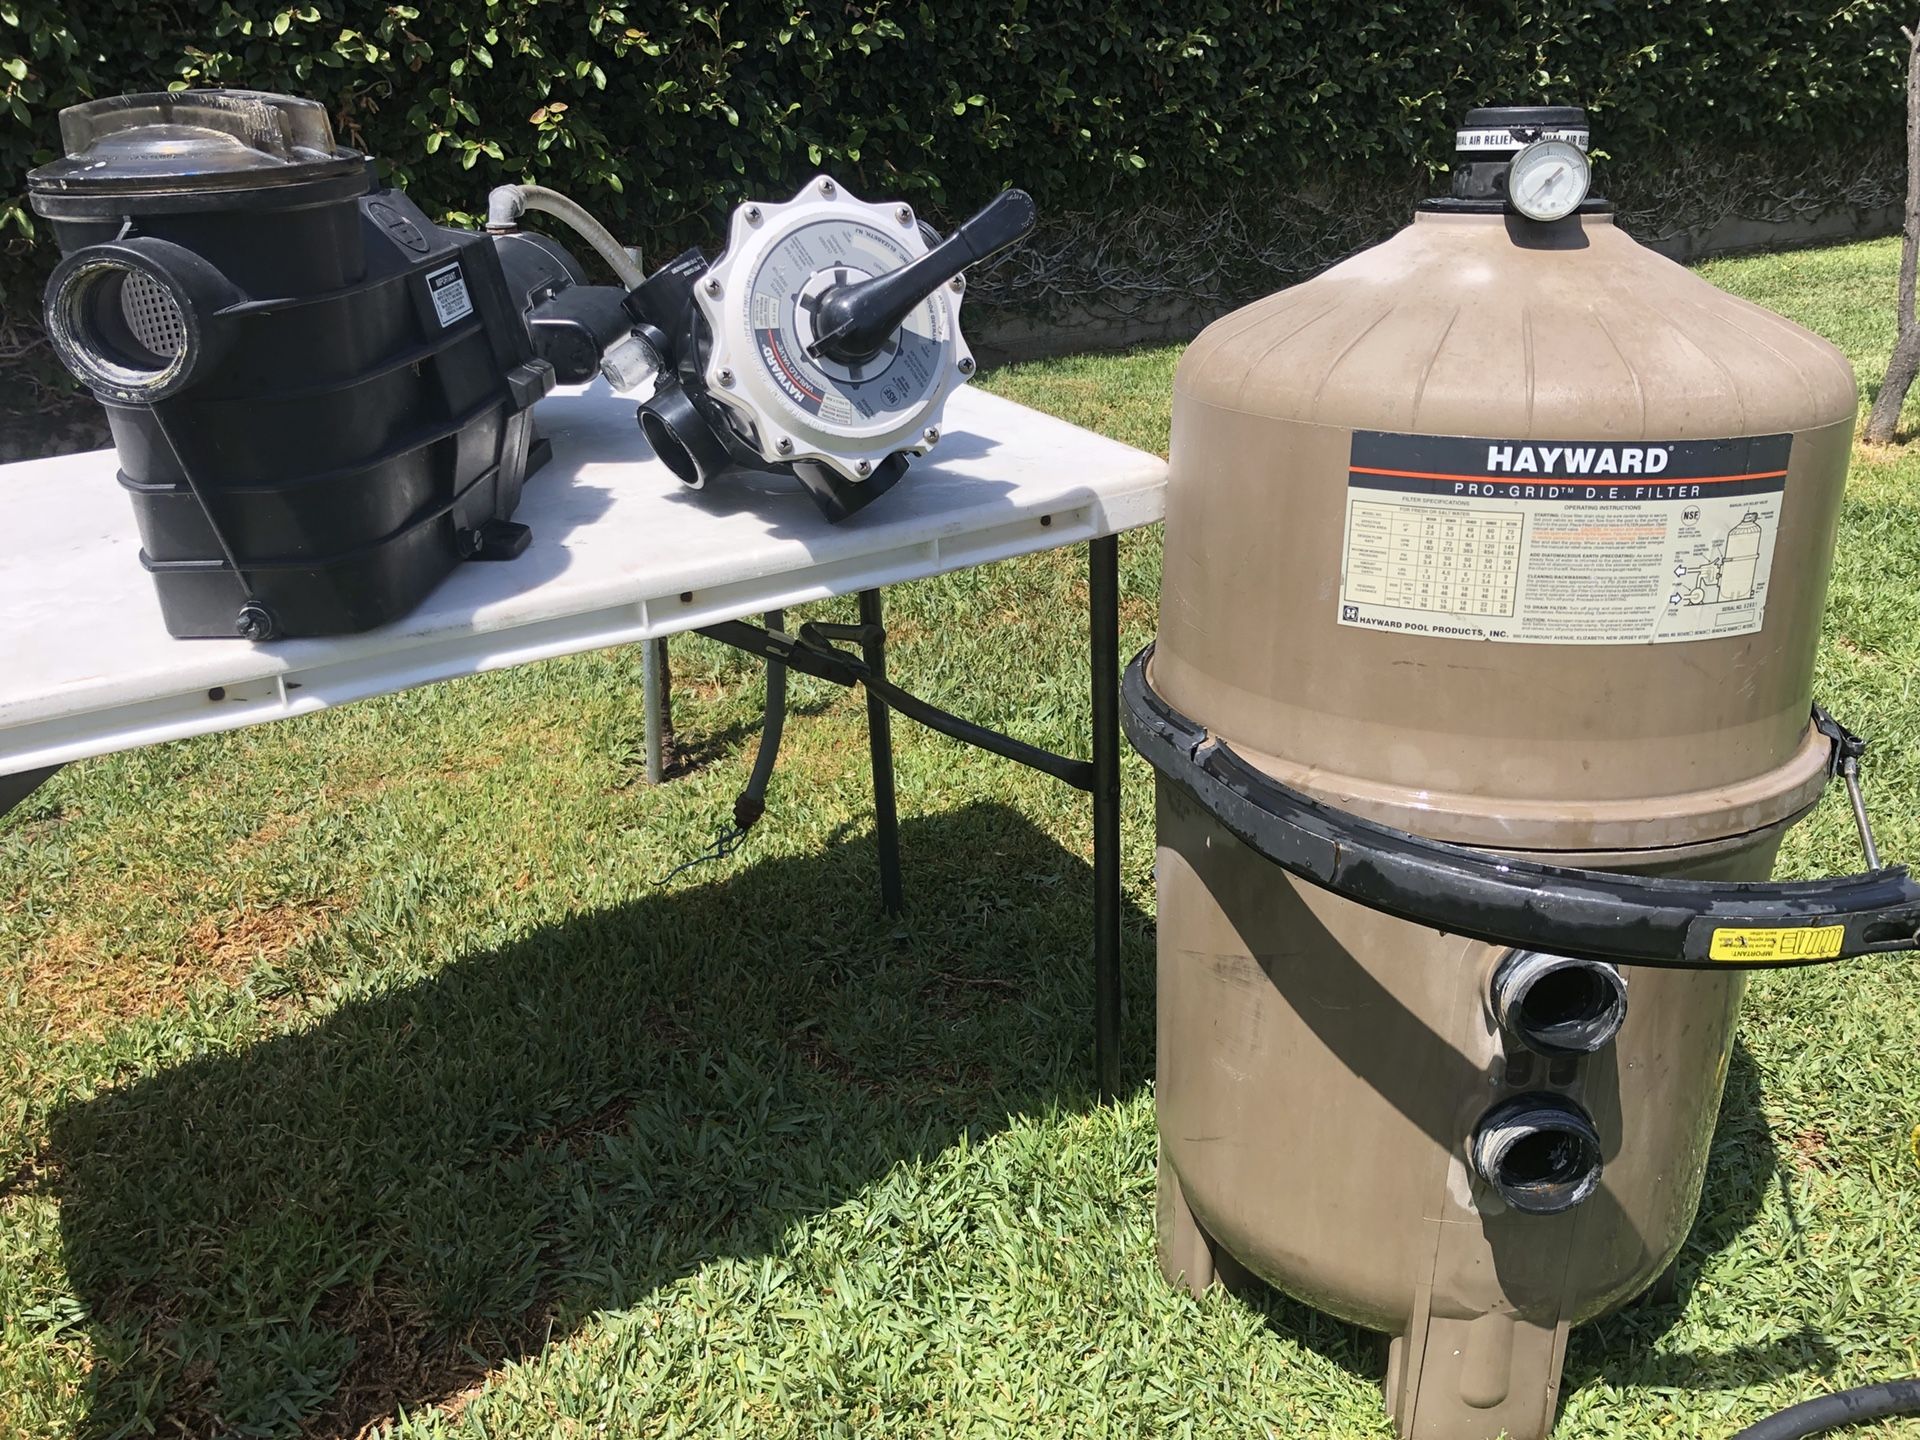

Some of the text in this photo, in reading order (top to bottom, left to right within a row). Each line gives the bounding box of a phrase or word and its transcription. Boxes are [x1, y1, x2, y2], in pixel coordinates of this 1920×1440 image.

[1469, 136, 1480, 145] AIR
[1484, 134, 1513, 145] RELIEF
[1566, 134, 1578, 145] AIR
[884, 388, 898, 404] NSF
[1636, 486, 1700, 498] FILTER
[1422, 498, 1470, 506] SPECIFICATIONS
[1684, 511, 1699, 520] NSF
[1360, 617, 1509, 638] HAYWARD POOL PRODUCTS, INC.
